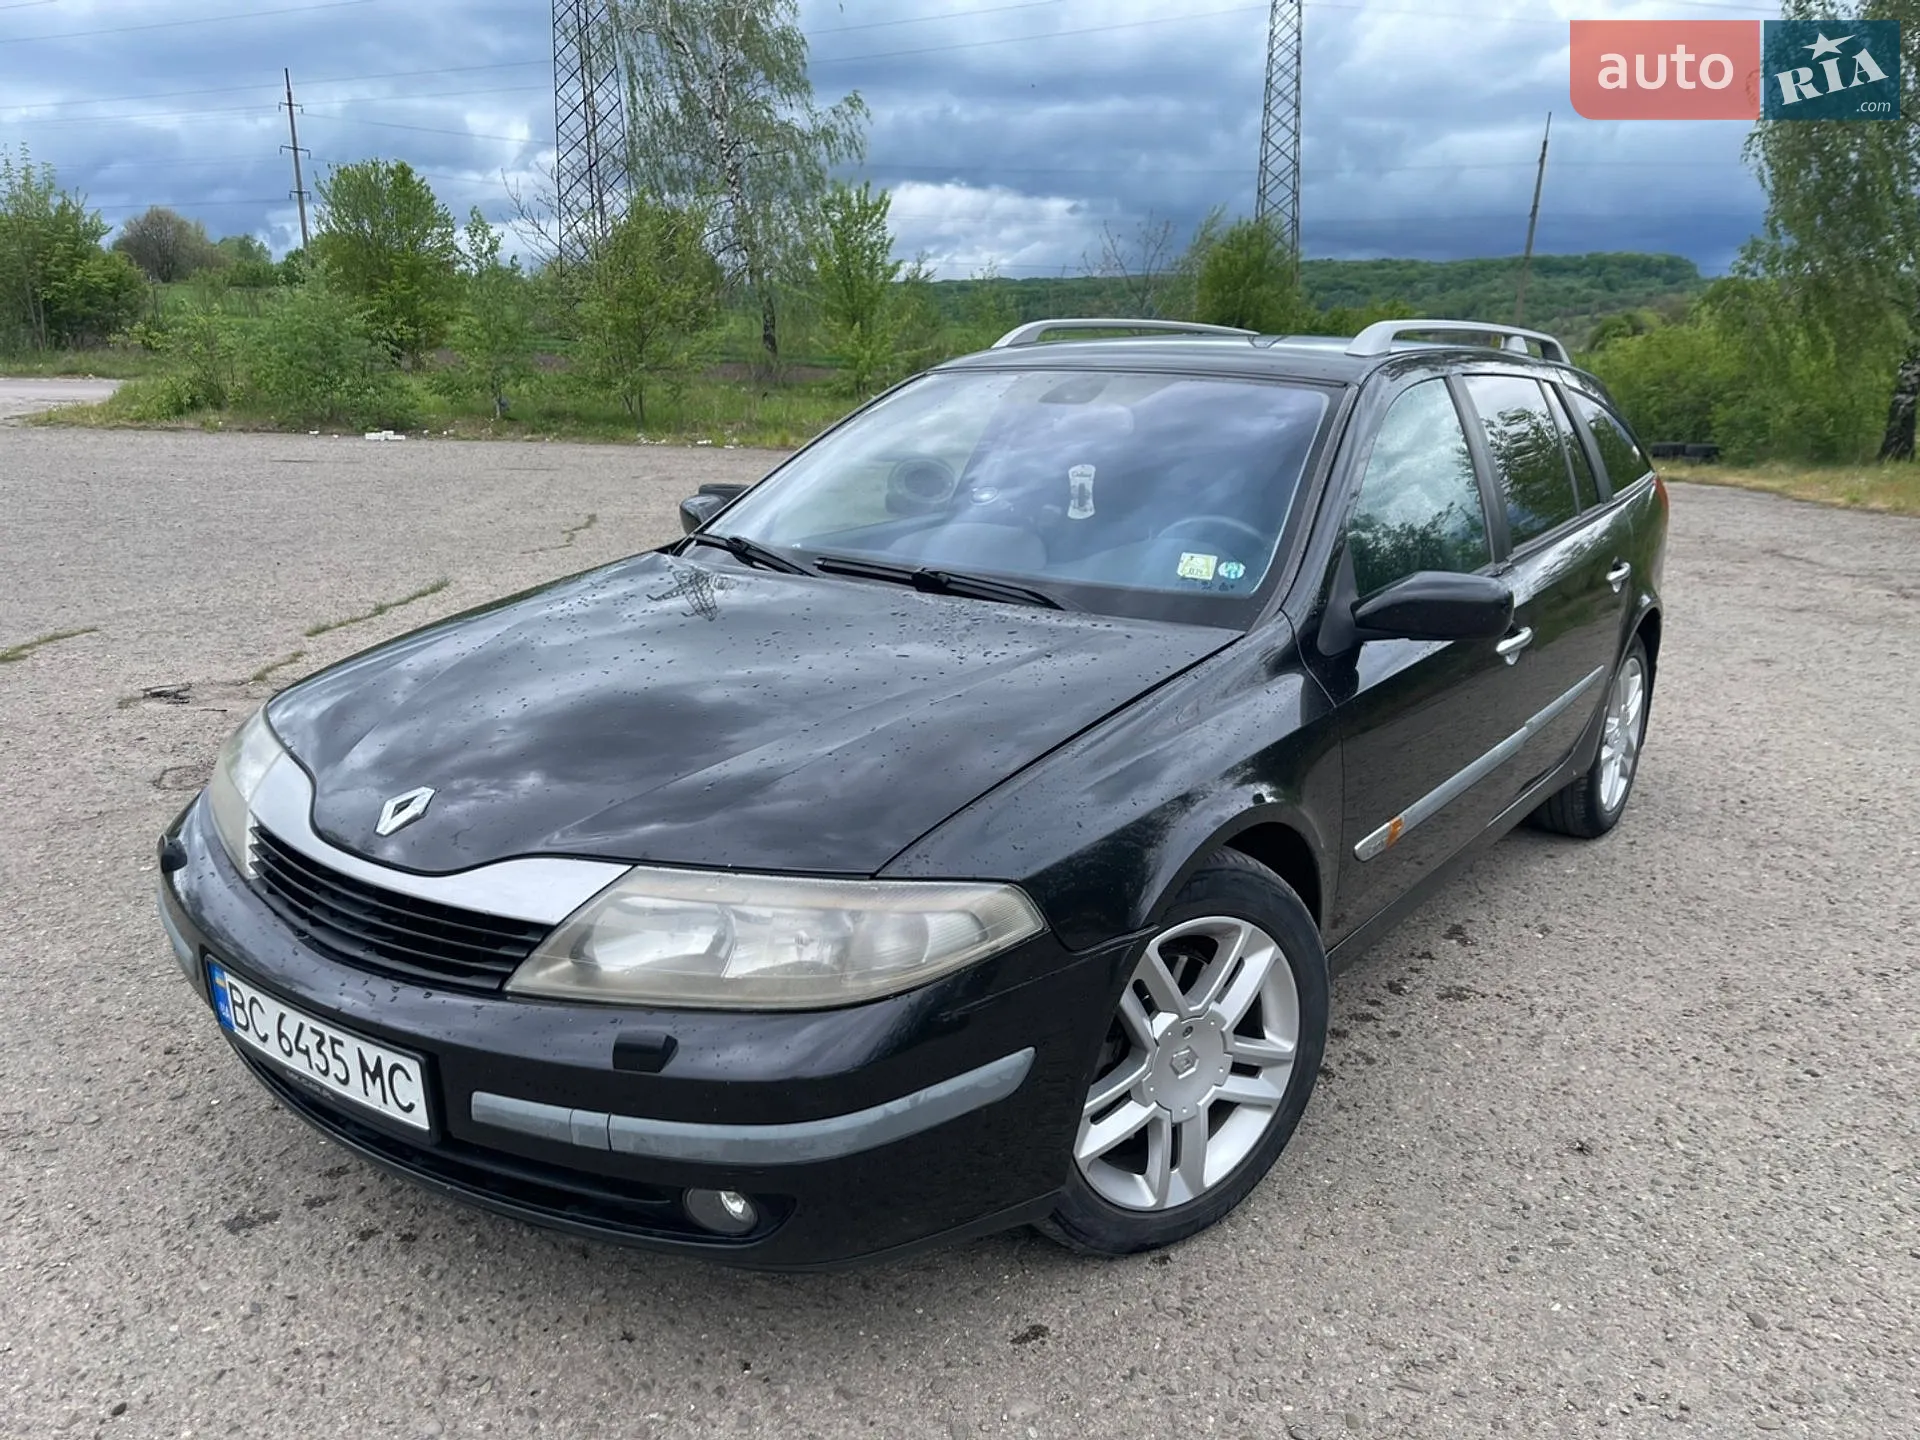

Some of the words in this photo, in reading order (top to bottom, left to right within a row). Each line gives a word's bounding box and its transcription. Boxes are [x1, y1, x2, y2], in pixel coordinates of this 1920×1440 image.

[227, 980, 269, 1044] BC
[277, 1012, 350, 1086] 6435
[357, 1046, 416, 1114] MC
